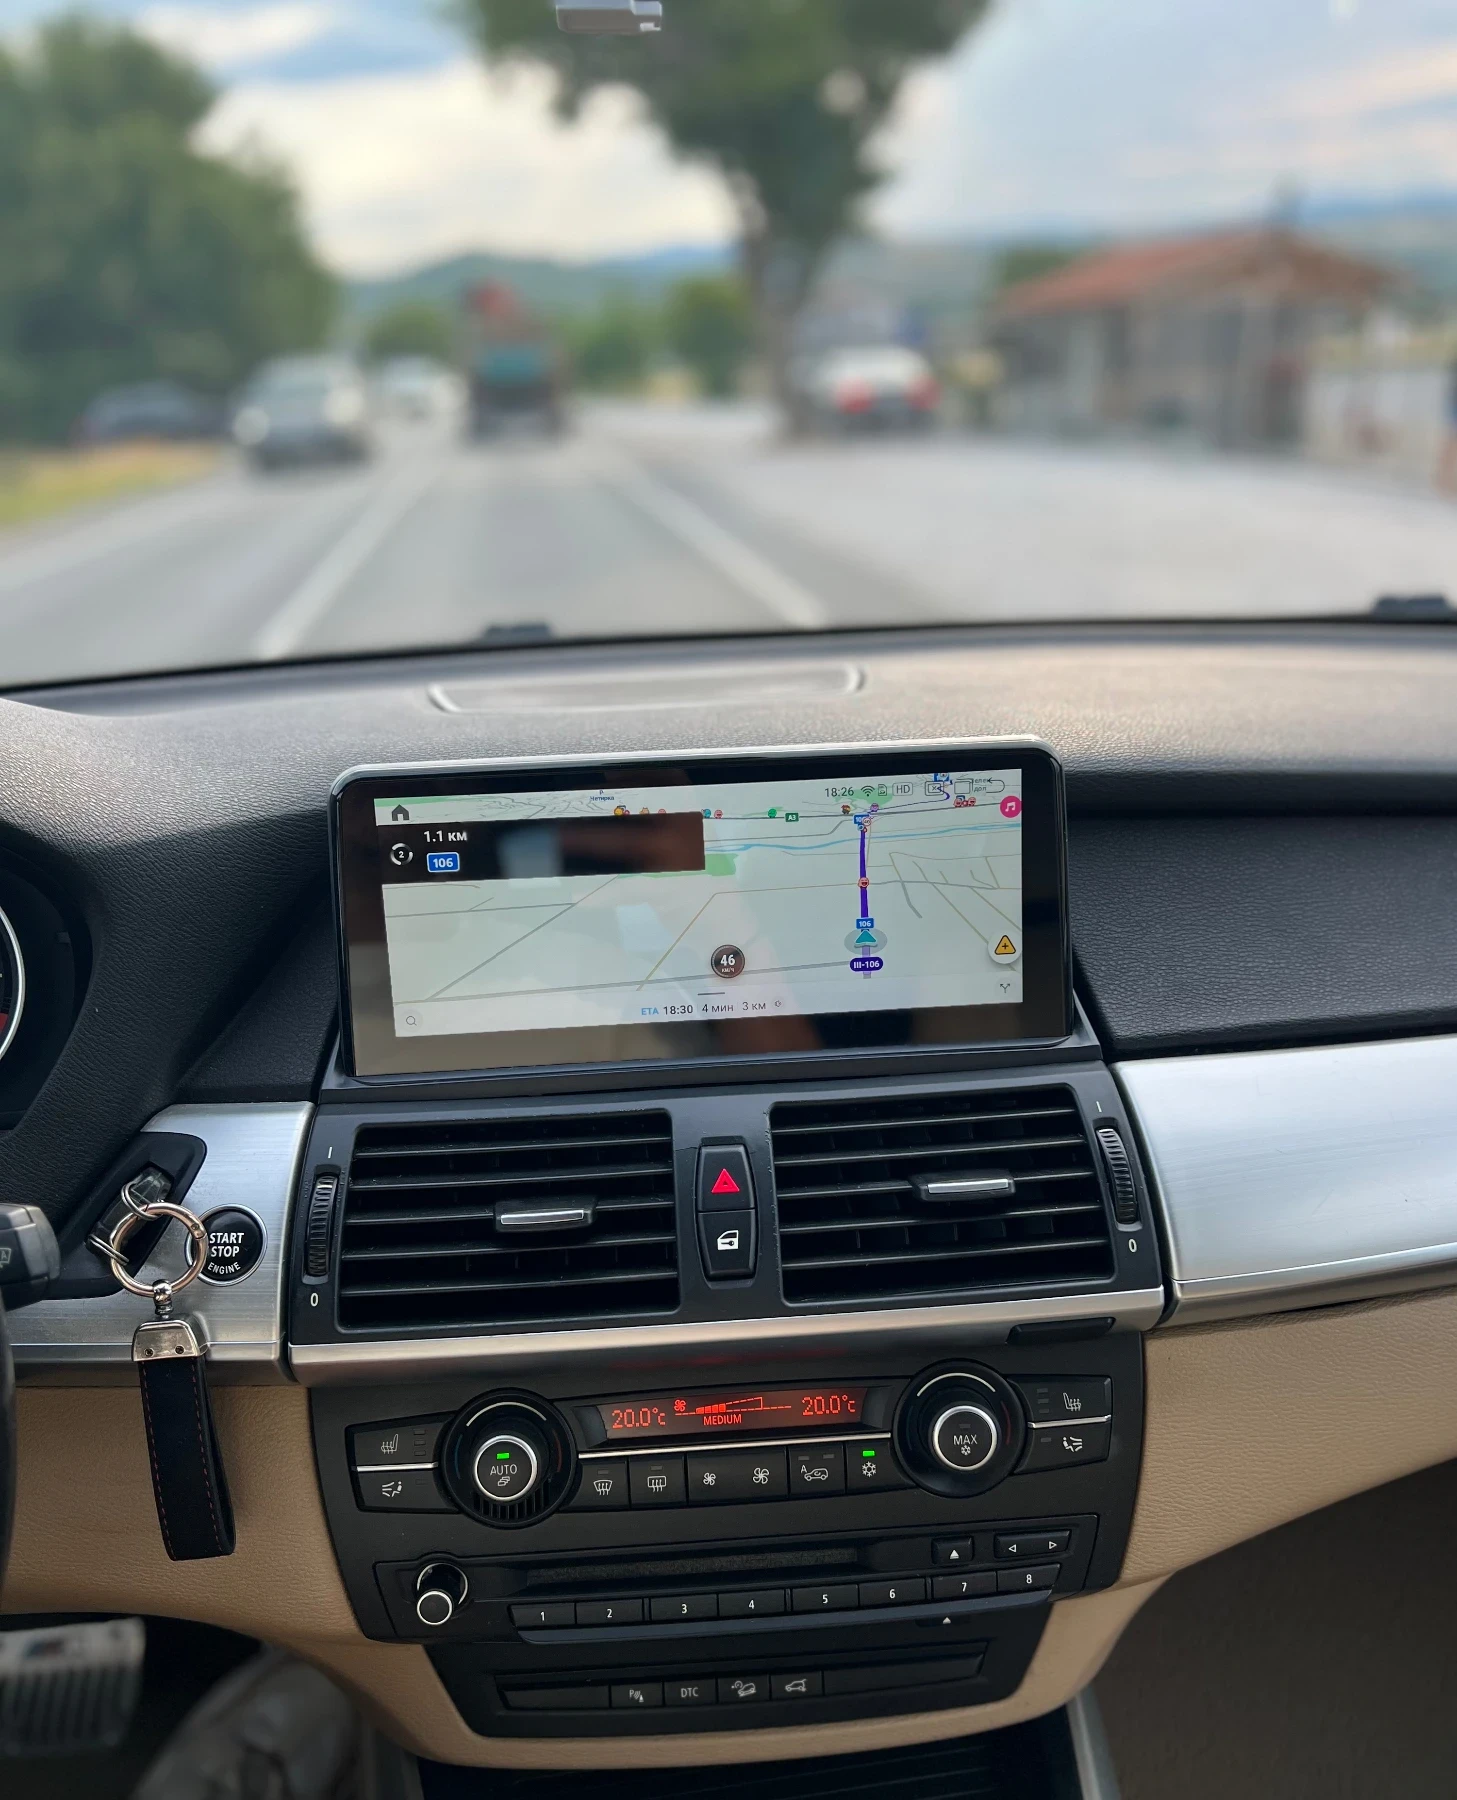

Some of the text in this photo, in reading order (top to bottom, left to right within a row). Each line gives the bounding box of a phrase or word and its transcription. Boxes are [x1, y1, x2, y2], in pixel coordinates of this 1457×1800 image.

[825, 787, 854, 797] 18:26
[896, 784, 911, 794] HD
[424, 831, 443, 843] 1.1
[399, 850, 404, 858] 2
[433, 857, 454, 869] 106
[859, 920, 872, 928] 106
[720, 954, 736, 966] 46
[853, 960, 880, 969] III-106
[641, 1001, 767, 1016] ETA 18:30 4 мин 3 км
[209, 1232, 245, 1244] START
[210, 1245, 240, 1258] STOP
[207, 1261, 241, 1275] ENGINE
[703, 1413, 742, 1426] MEDIUM
[953, 1434, 978, 1446] MAX
[490, 1464, 518, 1477] AUTO
[1026, 1574, 1032, 1584] 8
[961, 1582, 967, 1592] 7
[822, 1594, 828, 1604] 5
[889, 1589, 896, 1599] 6
[681, 1604, 688, 1614] 3
[748, 1600, 755, 1610] 4
[540, 1611, 545, 1621] 1
[607, 1608, 613, 1618] 2
[681, 1687, 699, 1698] DTC
